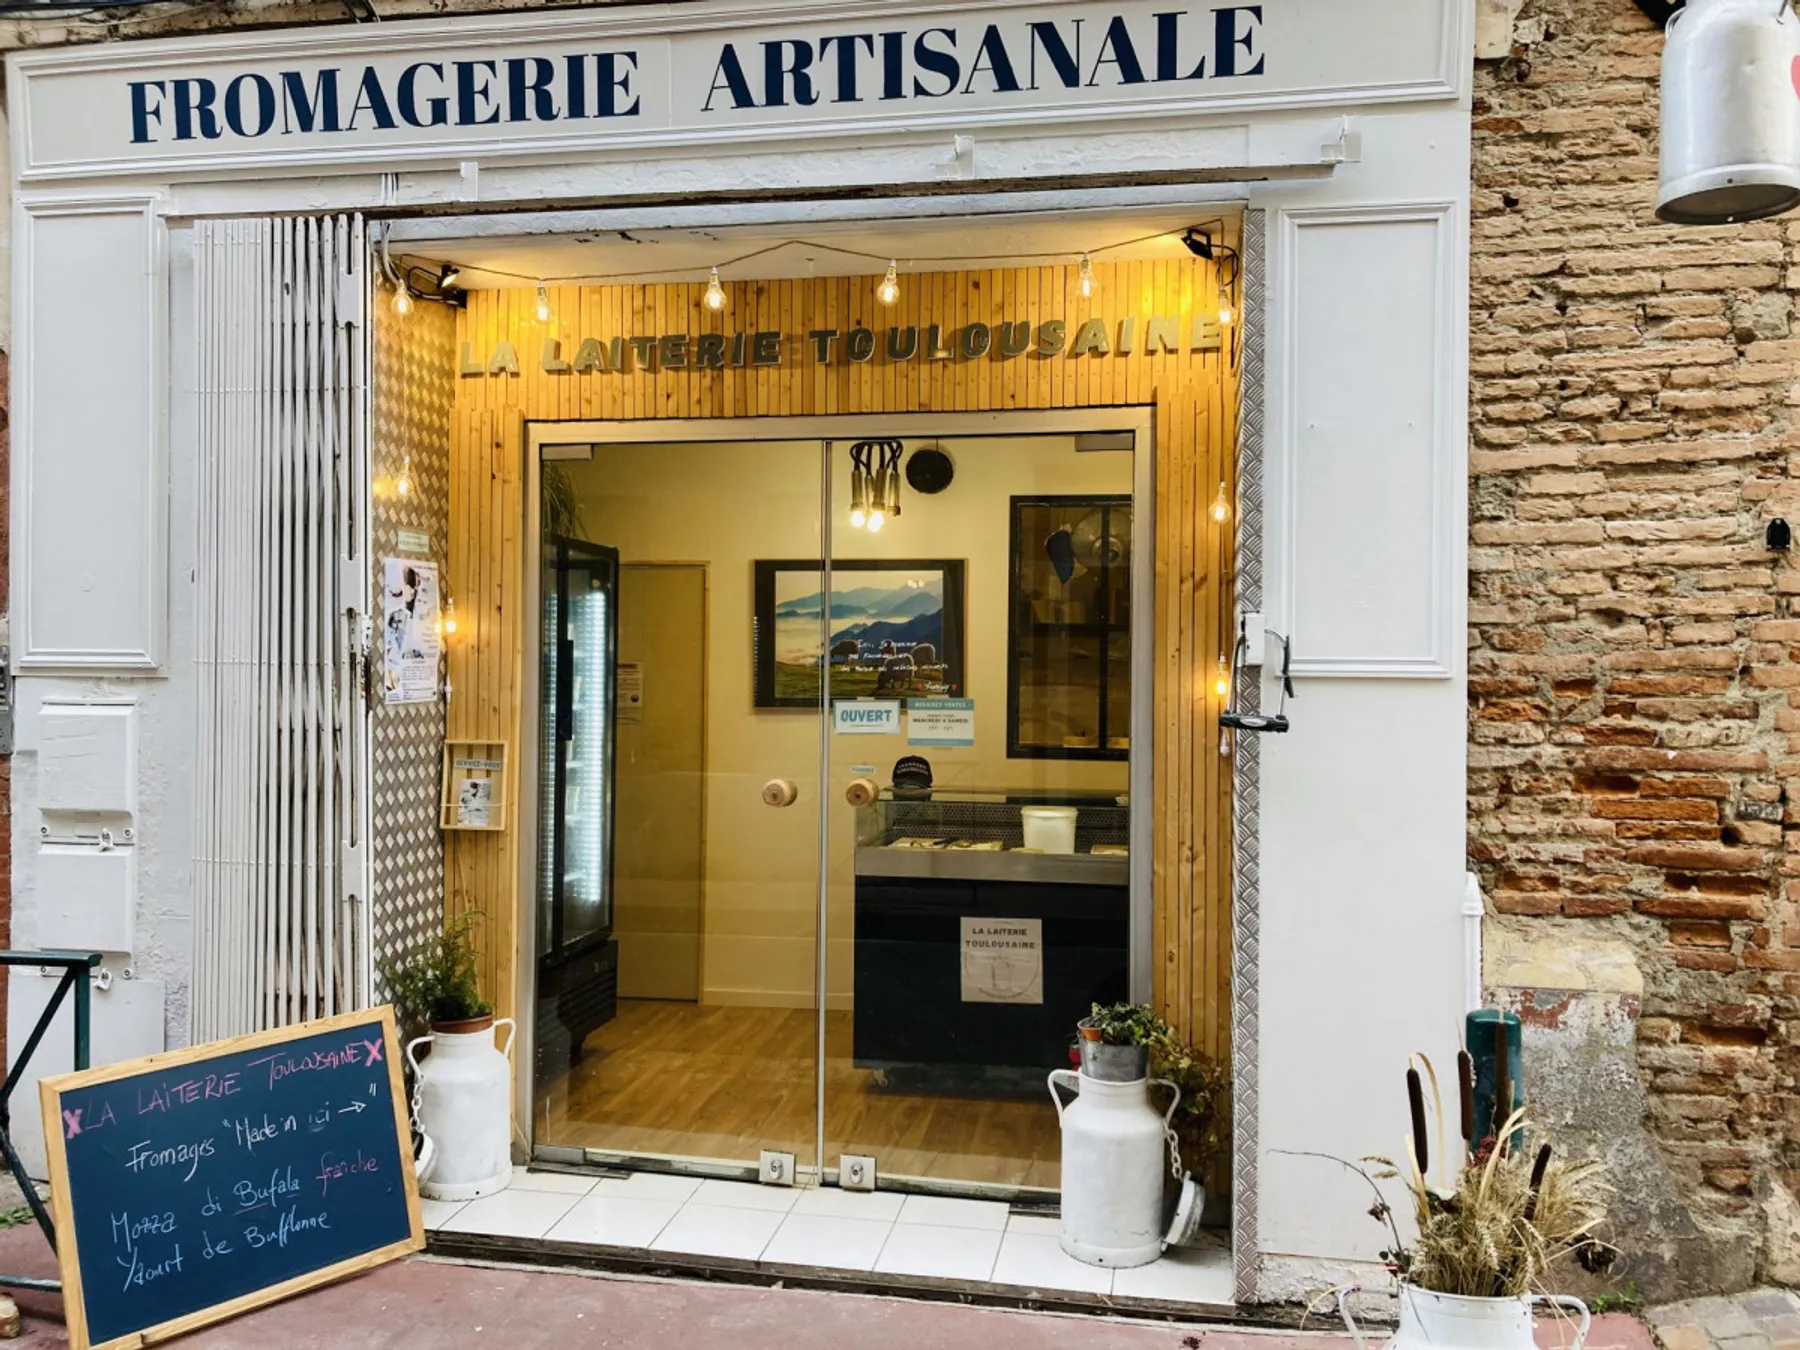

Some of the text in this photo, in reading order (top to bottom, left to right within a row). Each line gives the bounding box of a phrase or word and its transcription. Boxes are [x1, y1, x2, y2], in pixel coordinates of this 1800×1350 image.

[127, 5, 1265, 144] FROMAGERIE ARTISANALE
[460, 313, 1222, 375] LA LAITERIE TOULOUSAINE
[840, 709, 893, 723] OUVERT
[965, 940, 1036, 949] TOULOUSAINE
[972, 927, 1028, 936] LA LAITERIE
[85, 1097, 117, 1130] LA
[247, 1042, 364, 1091] TOULOUSAINE
[125, 1138, 216, 1182] Fromages
[280, 1115, 297, 1131] in
[111, 1212, 177, 1253] Mozza
[201, 1185, 222, 1216] di
[233, 1165, 300, 1208] Bufala
[117, 1243, 184, 1293] Yaourt
[202, 1230, 233, 1259] de
